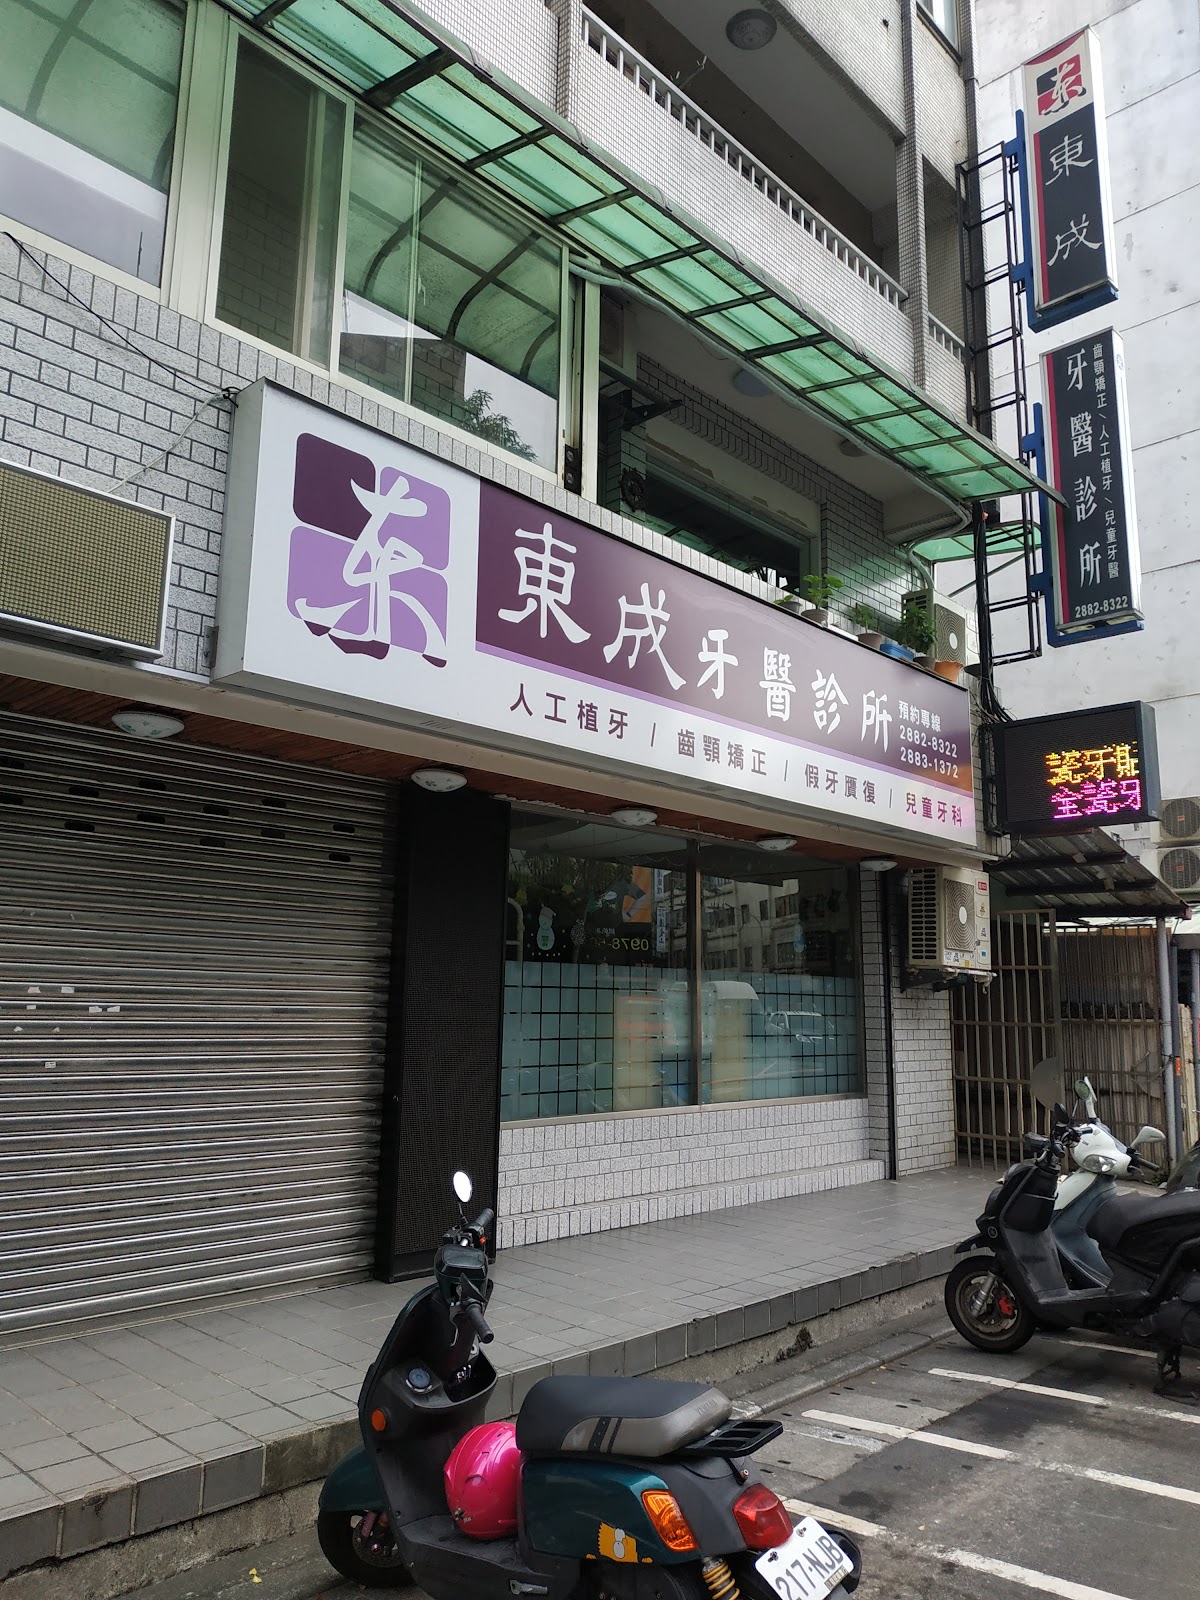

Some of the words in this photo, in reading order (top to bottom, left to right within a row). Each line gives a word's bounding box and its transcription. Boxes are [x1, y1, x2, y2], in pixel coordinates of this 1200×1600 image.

[1044, 133, 1103, 267] 東成
[1092, 342, 1108, 409] 齒顎矯正
[1066, 347, 1102, 588] 牙醫診所
[1099, 424, 1113, 491] 人工植牙
[1104, 509, 1120, 579] 兒童牙醫
[498, 522, 893, 753] 東成牙醫診所
[1074, 595, 1129, 619] 2882-8322
[898, 699, 942, 733] 預約專線
[899, 724, 958, 759] 2882-8322
[509, 682, 629, 740] 人工植牙
[677, 728, 767, 776] 齒顎矯正
[905, 792, 963, 827] 兒童牙科
[900, 746, 959, 779] 2883-1372
